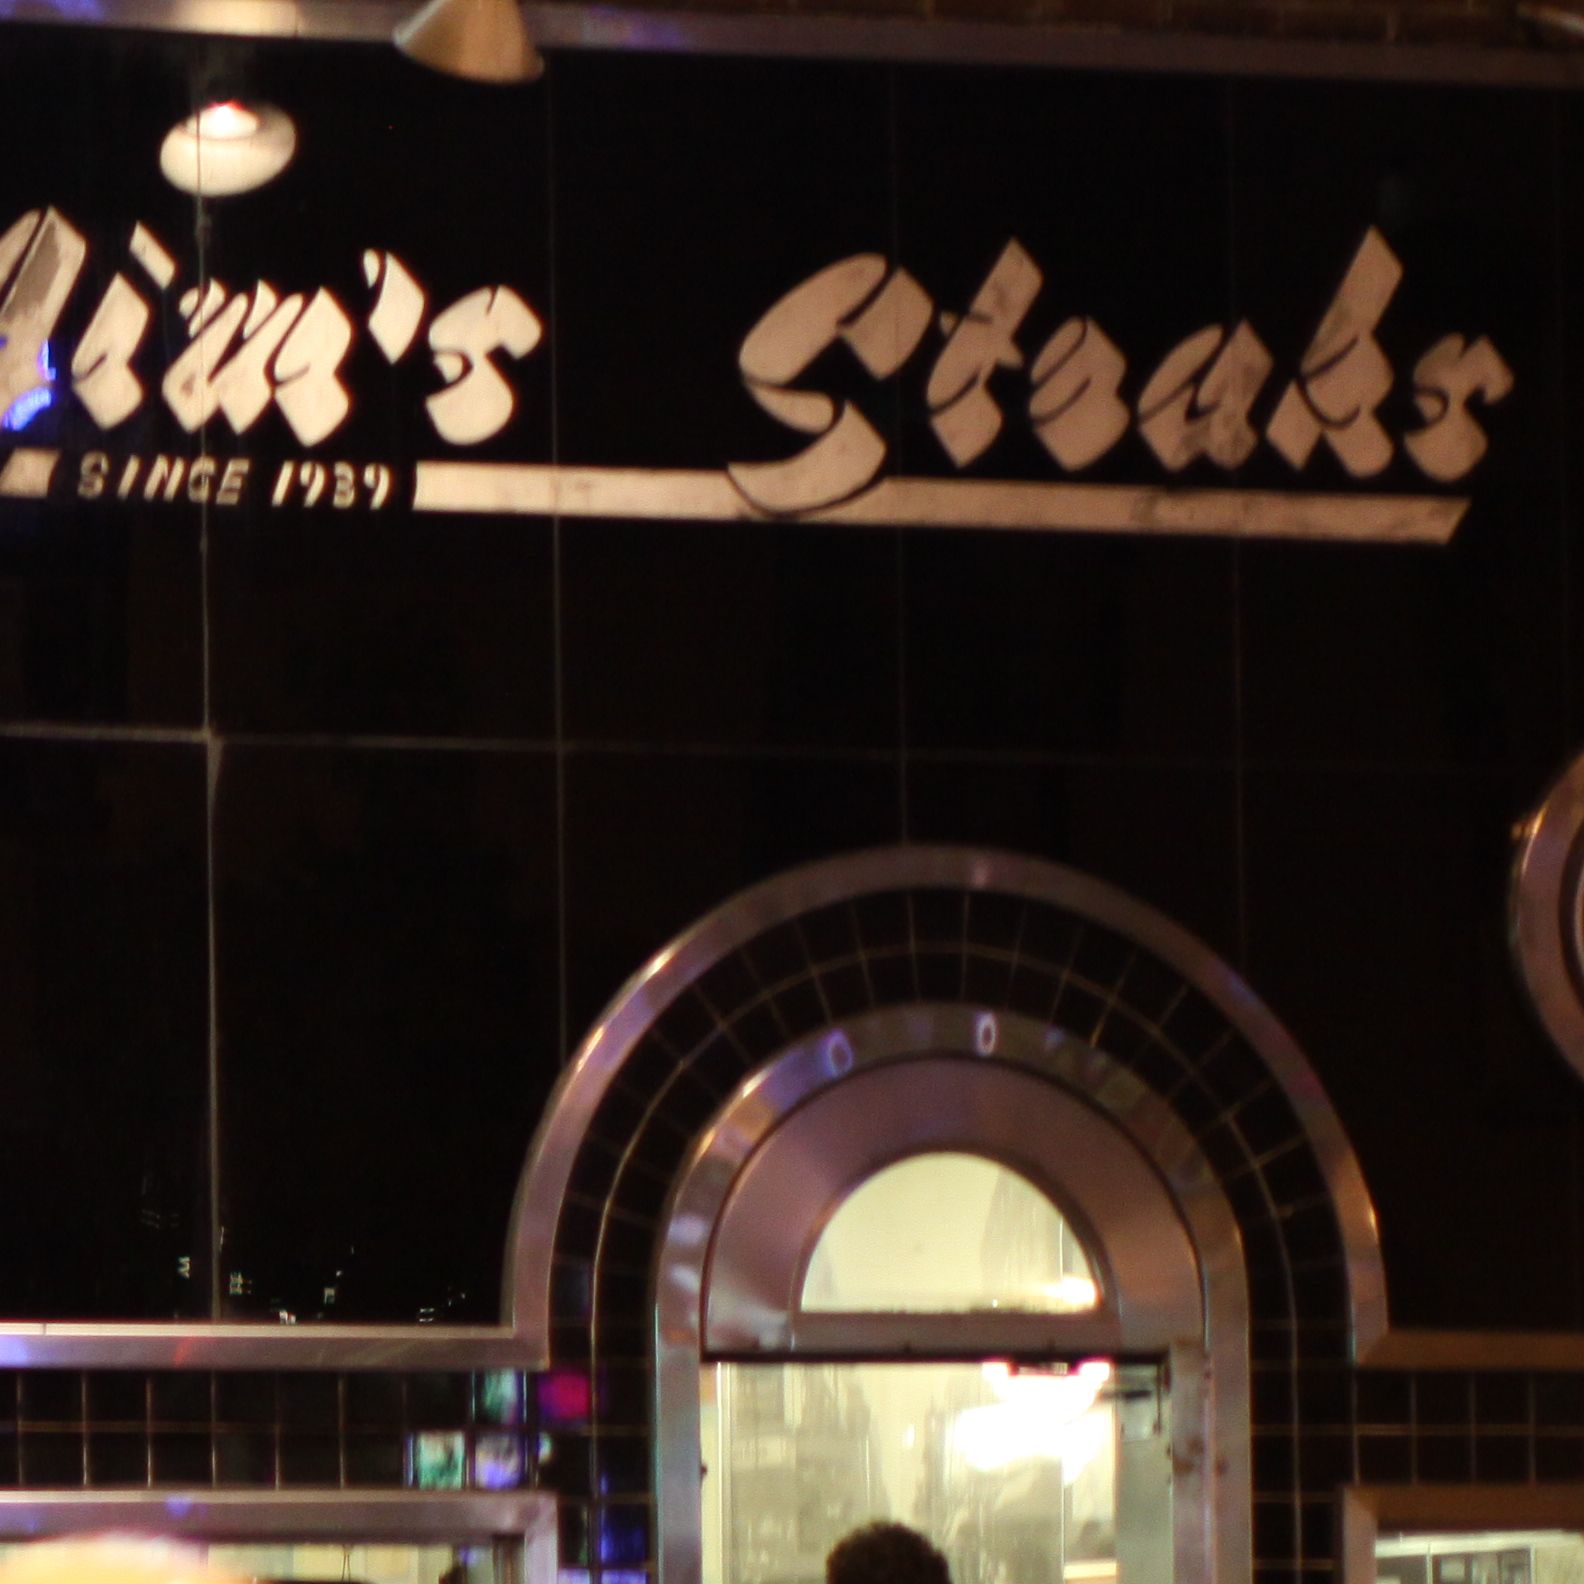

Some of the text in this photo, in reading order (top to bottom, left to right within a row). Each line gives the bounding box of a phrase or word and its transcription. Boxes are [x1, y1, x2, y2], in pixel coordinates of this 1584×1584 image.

[726, 225, 1516, 514] Steaks
[76, 451, 390, 511] SINCE 1939
